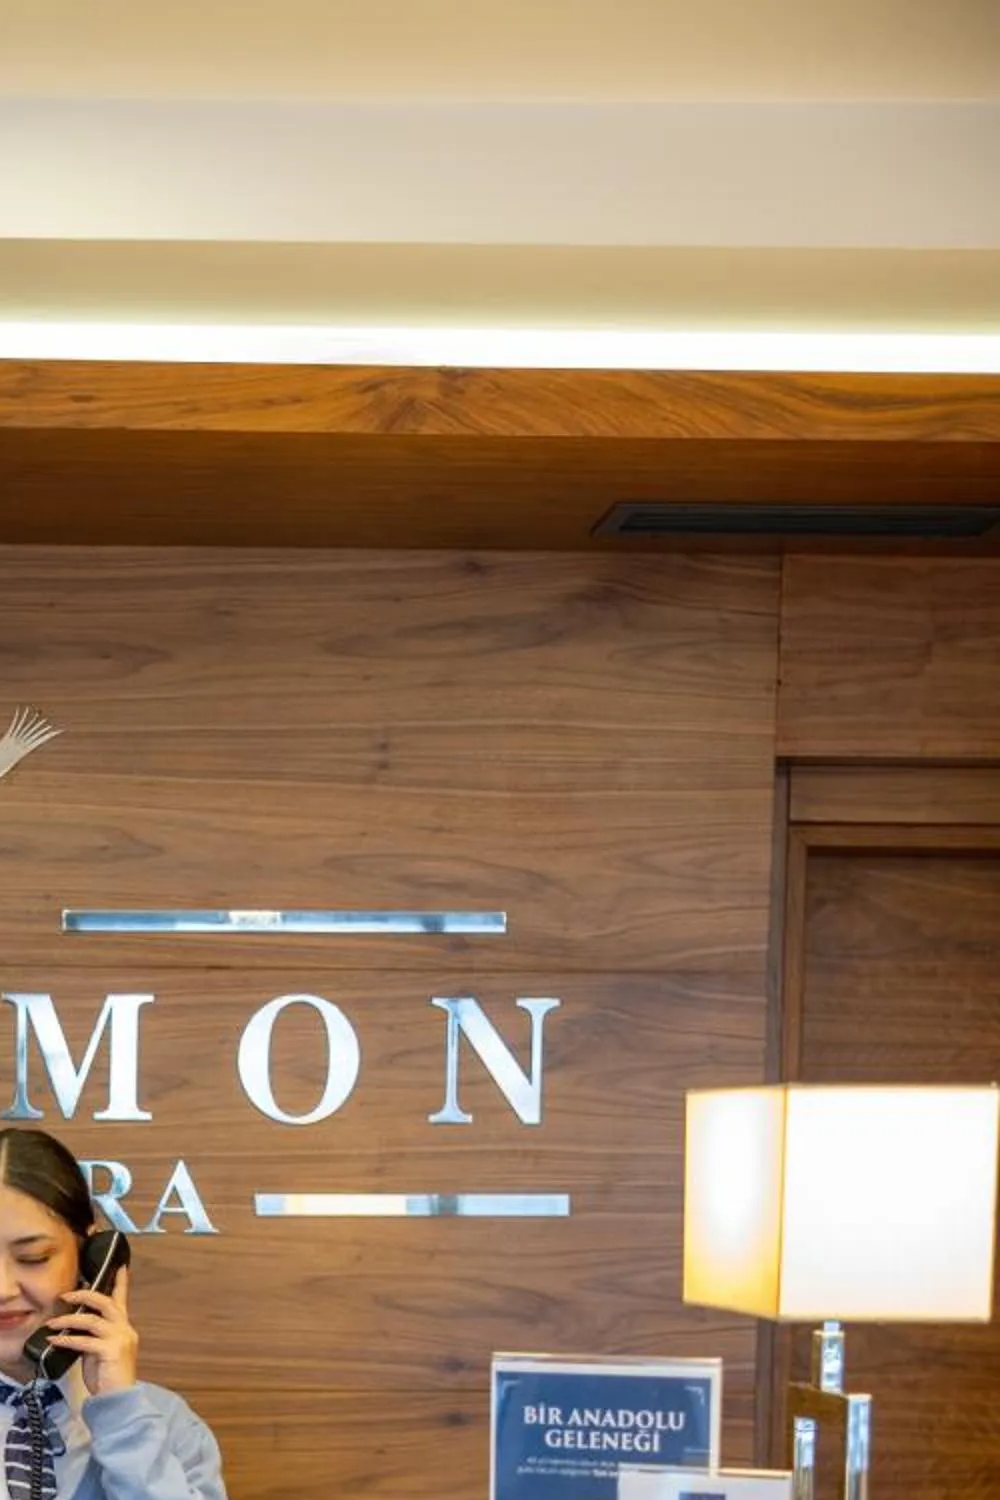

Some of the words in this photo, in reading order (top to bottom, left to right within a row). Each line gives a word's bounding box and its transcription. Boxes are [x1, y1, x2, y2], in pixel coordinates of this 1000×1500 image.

[523, 1402, 563, 1426] BİR
[568, 1407, 687, 1431] ANADOLU
[544, 1429, 661, 1453] GELENEĞİ
